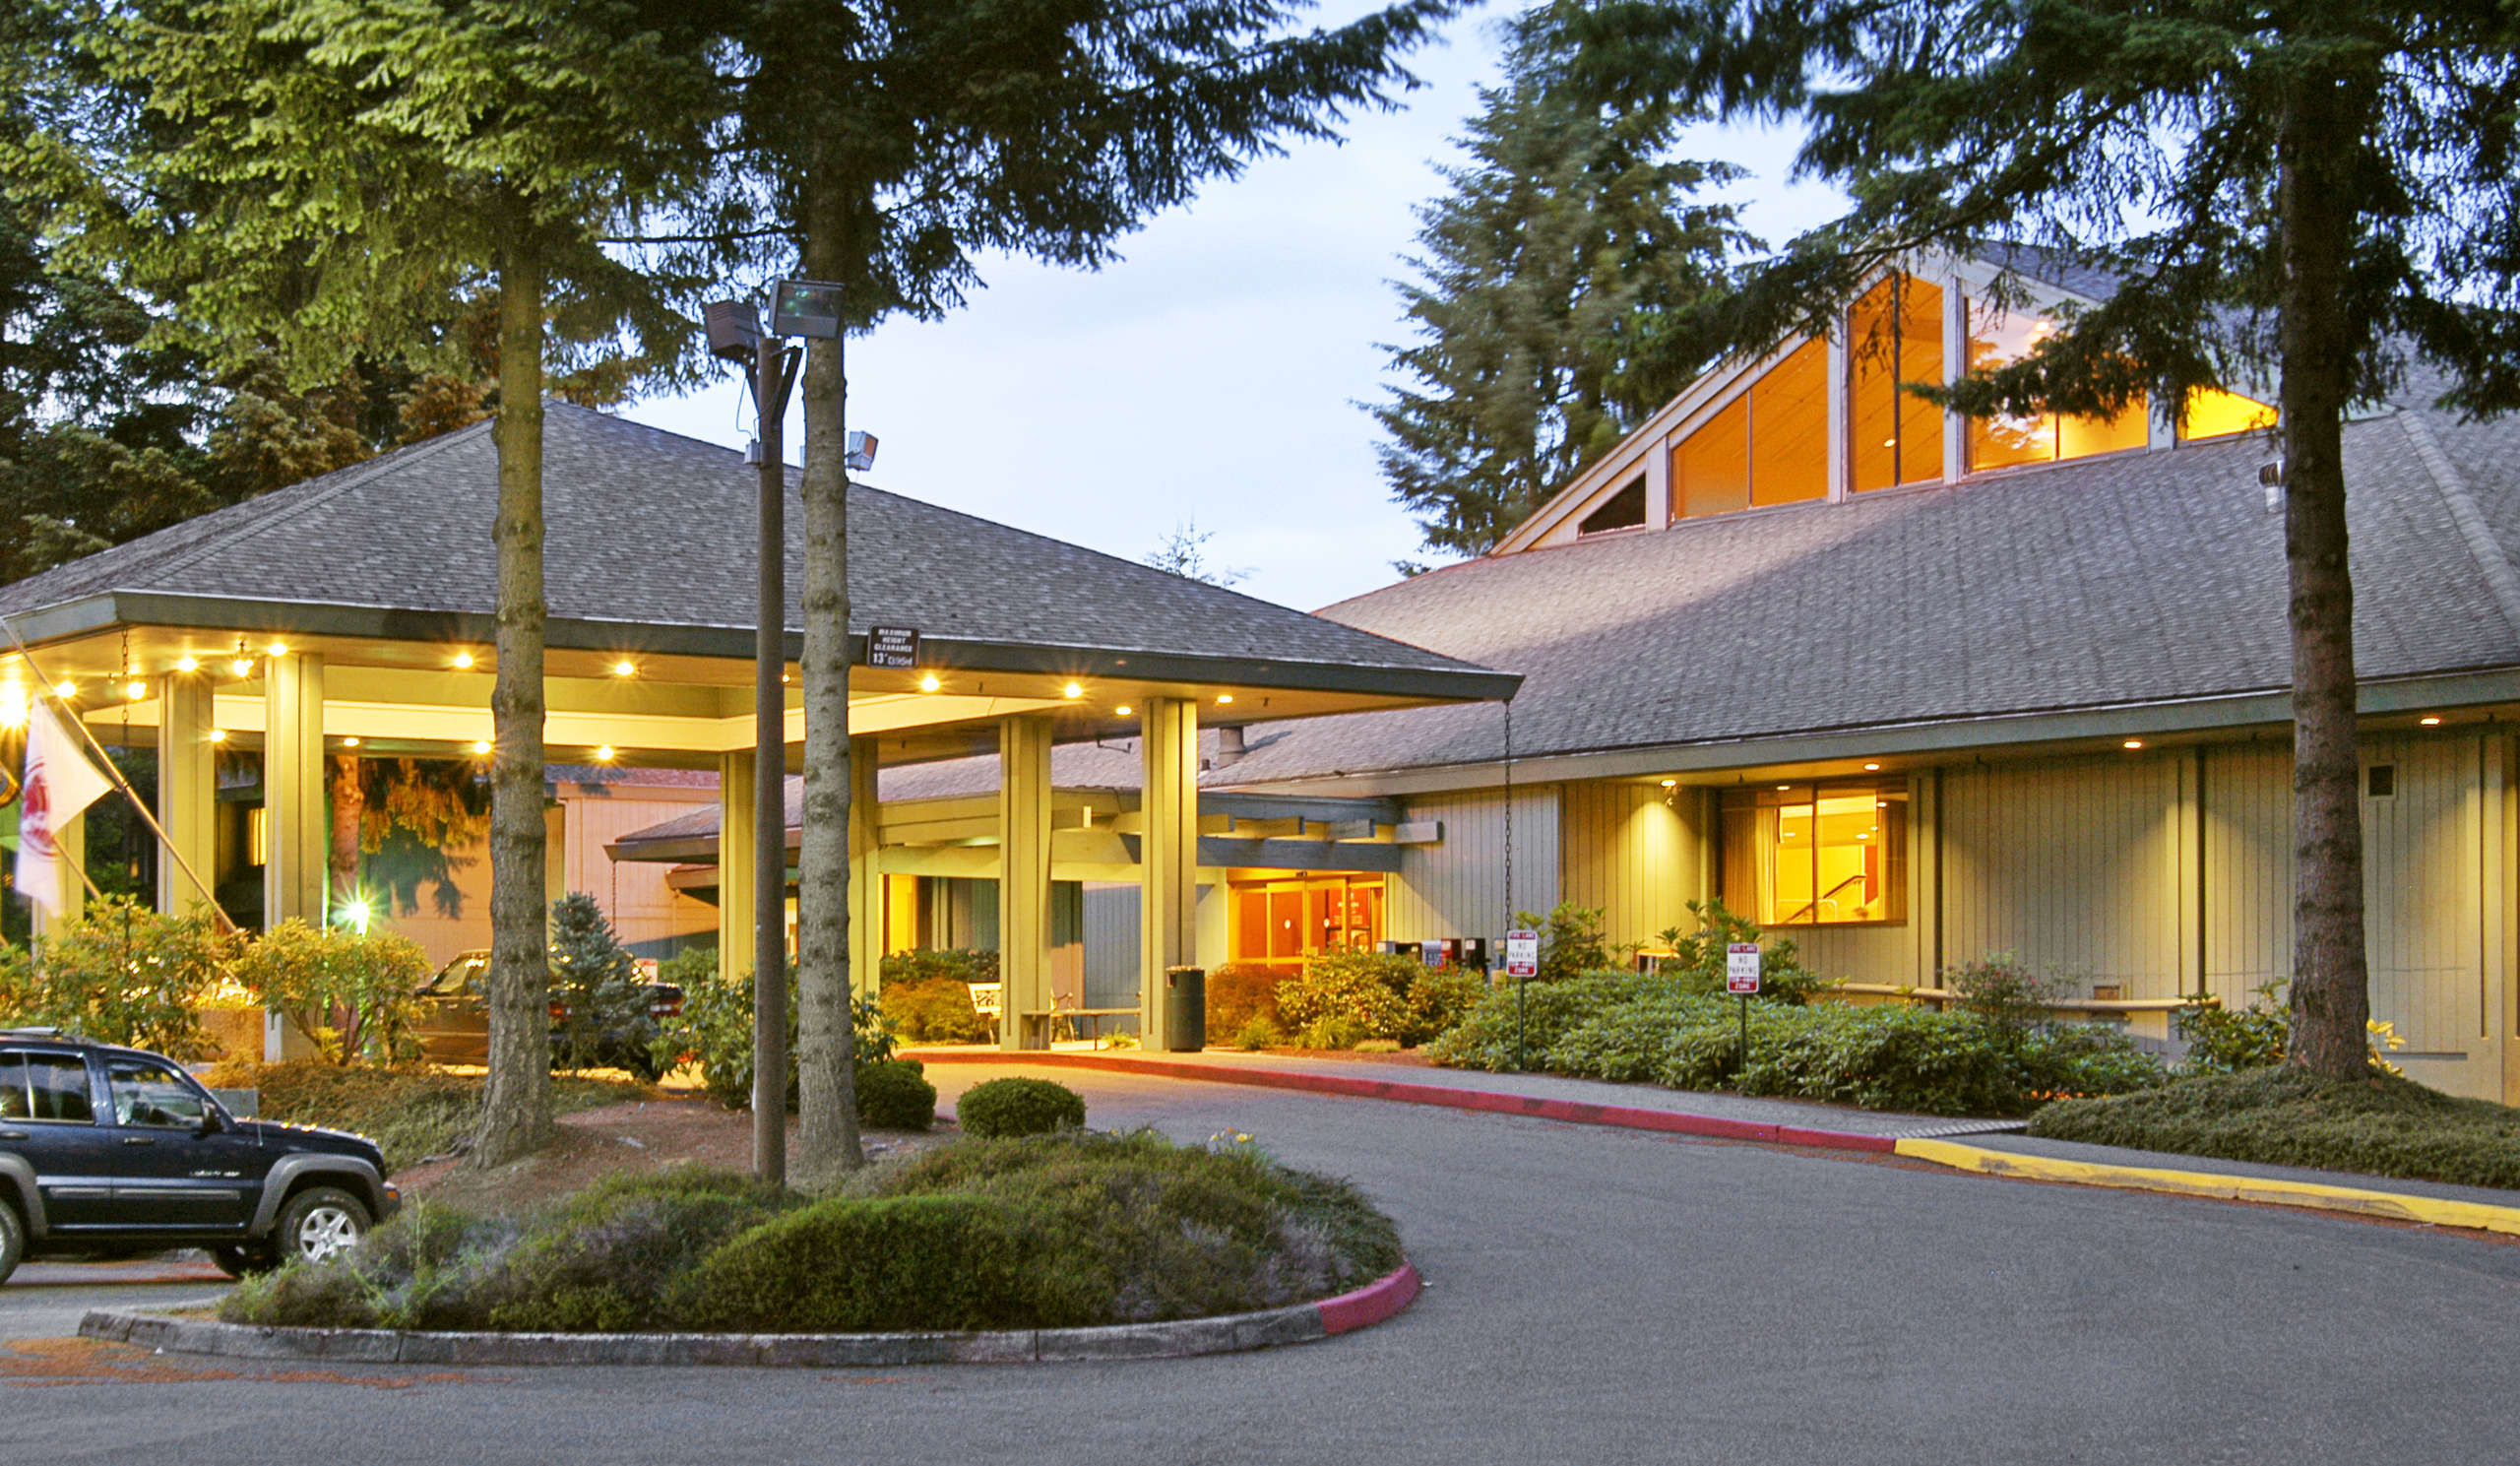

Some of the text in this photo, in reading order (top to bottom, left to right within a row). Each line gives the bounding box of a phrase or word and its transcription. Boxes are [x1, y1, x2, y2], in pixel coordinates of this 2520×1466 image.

[874, 643, 913, 652] CLEARANCE
[1517, 942, 1527, 951] NO
[1508, 951, 1536, 960] PARKING
[1738, 955, 1748, 965] NO
[1729, 966, 1757, 975] PARKING
